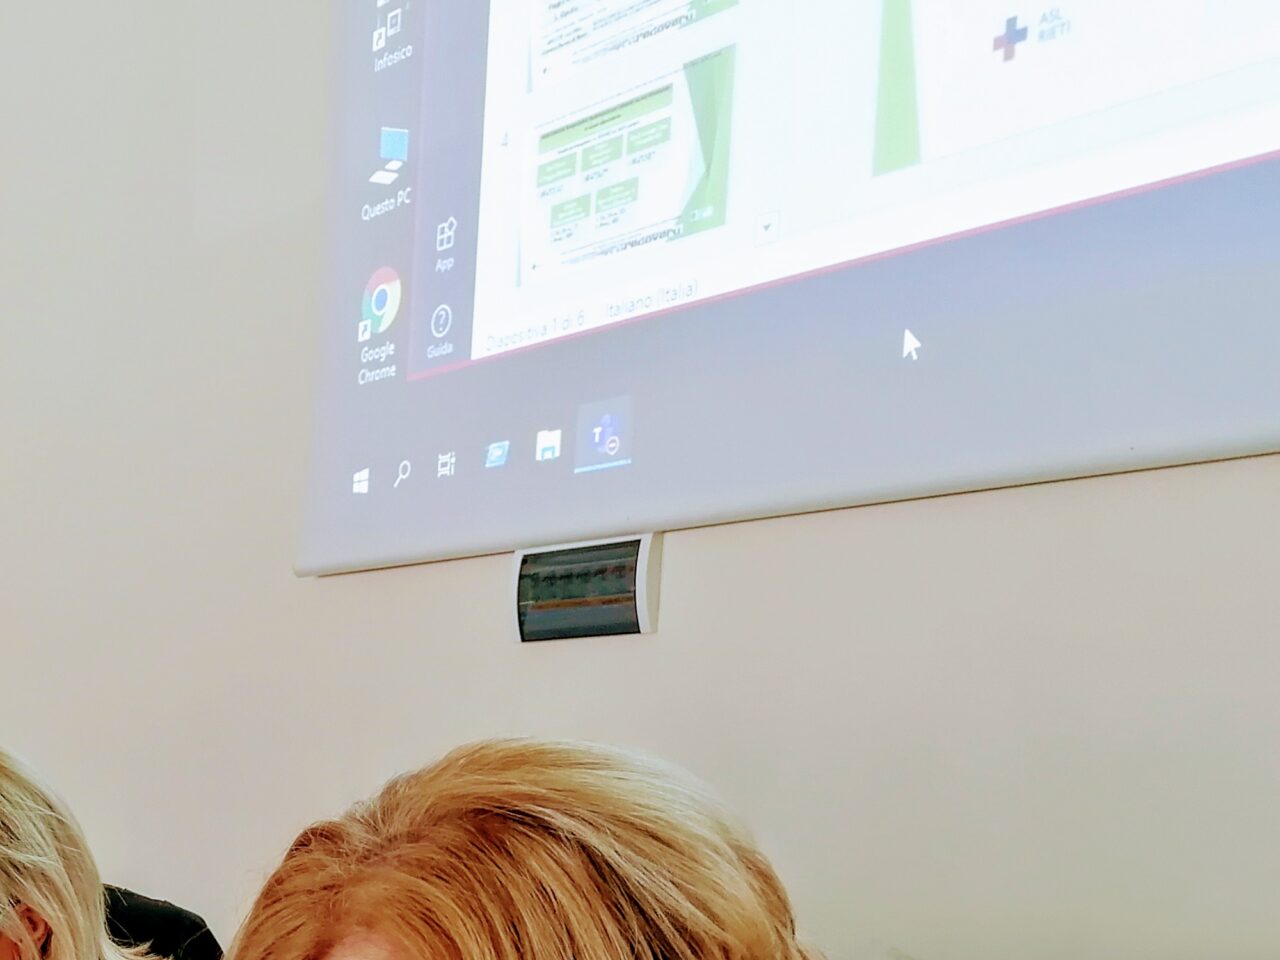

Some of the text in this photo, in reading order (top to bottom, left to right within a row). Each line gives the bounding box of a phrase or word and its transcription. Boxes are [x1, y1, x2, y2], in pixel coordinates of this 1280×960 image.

[361, 186, 413, 221] Questo PC
[435, 256, 455, 273] App
[360, 339, 396, 364] Google
[426, 340, 454, 359] Guida
[357, 362, 397, 386] Chrome
